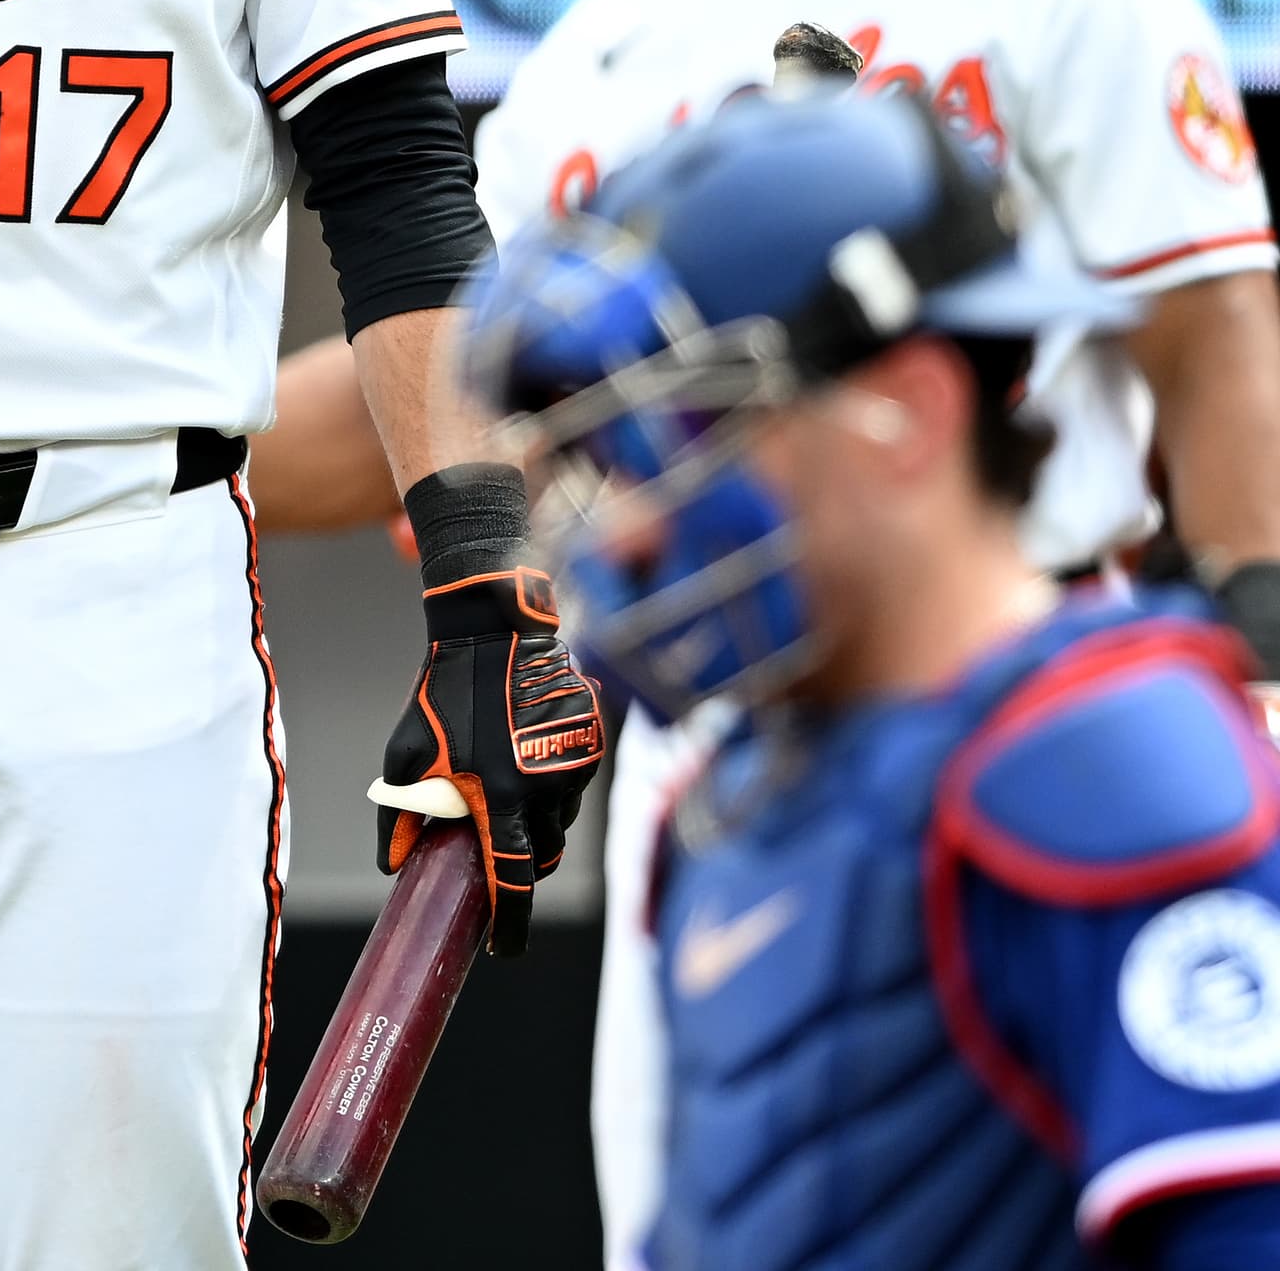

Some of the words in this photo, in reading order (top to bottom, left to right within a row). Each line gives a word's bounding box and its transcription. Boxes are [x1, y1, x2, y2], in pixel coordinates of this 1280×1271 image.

[360, 1016, 388, 1062] COLTON
[386, 1023, 401, 1047] PRO
[336, 1065, 367, 1116] COWSER
